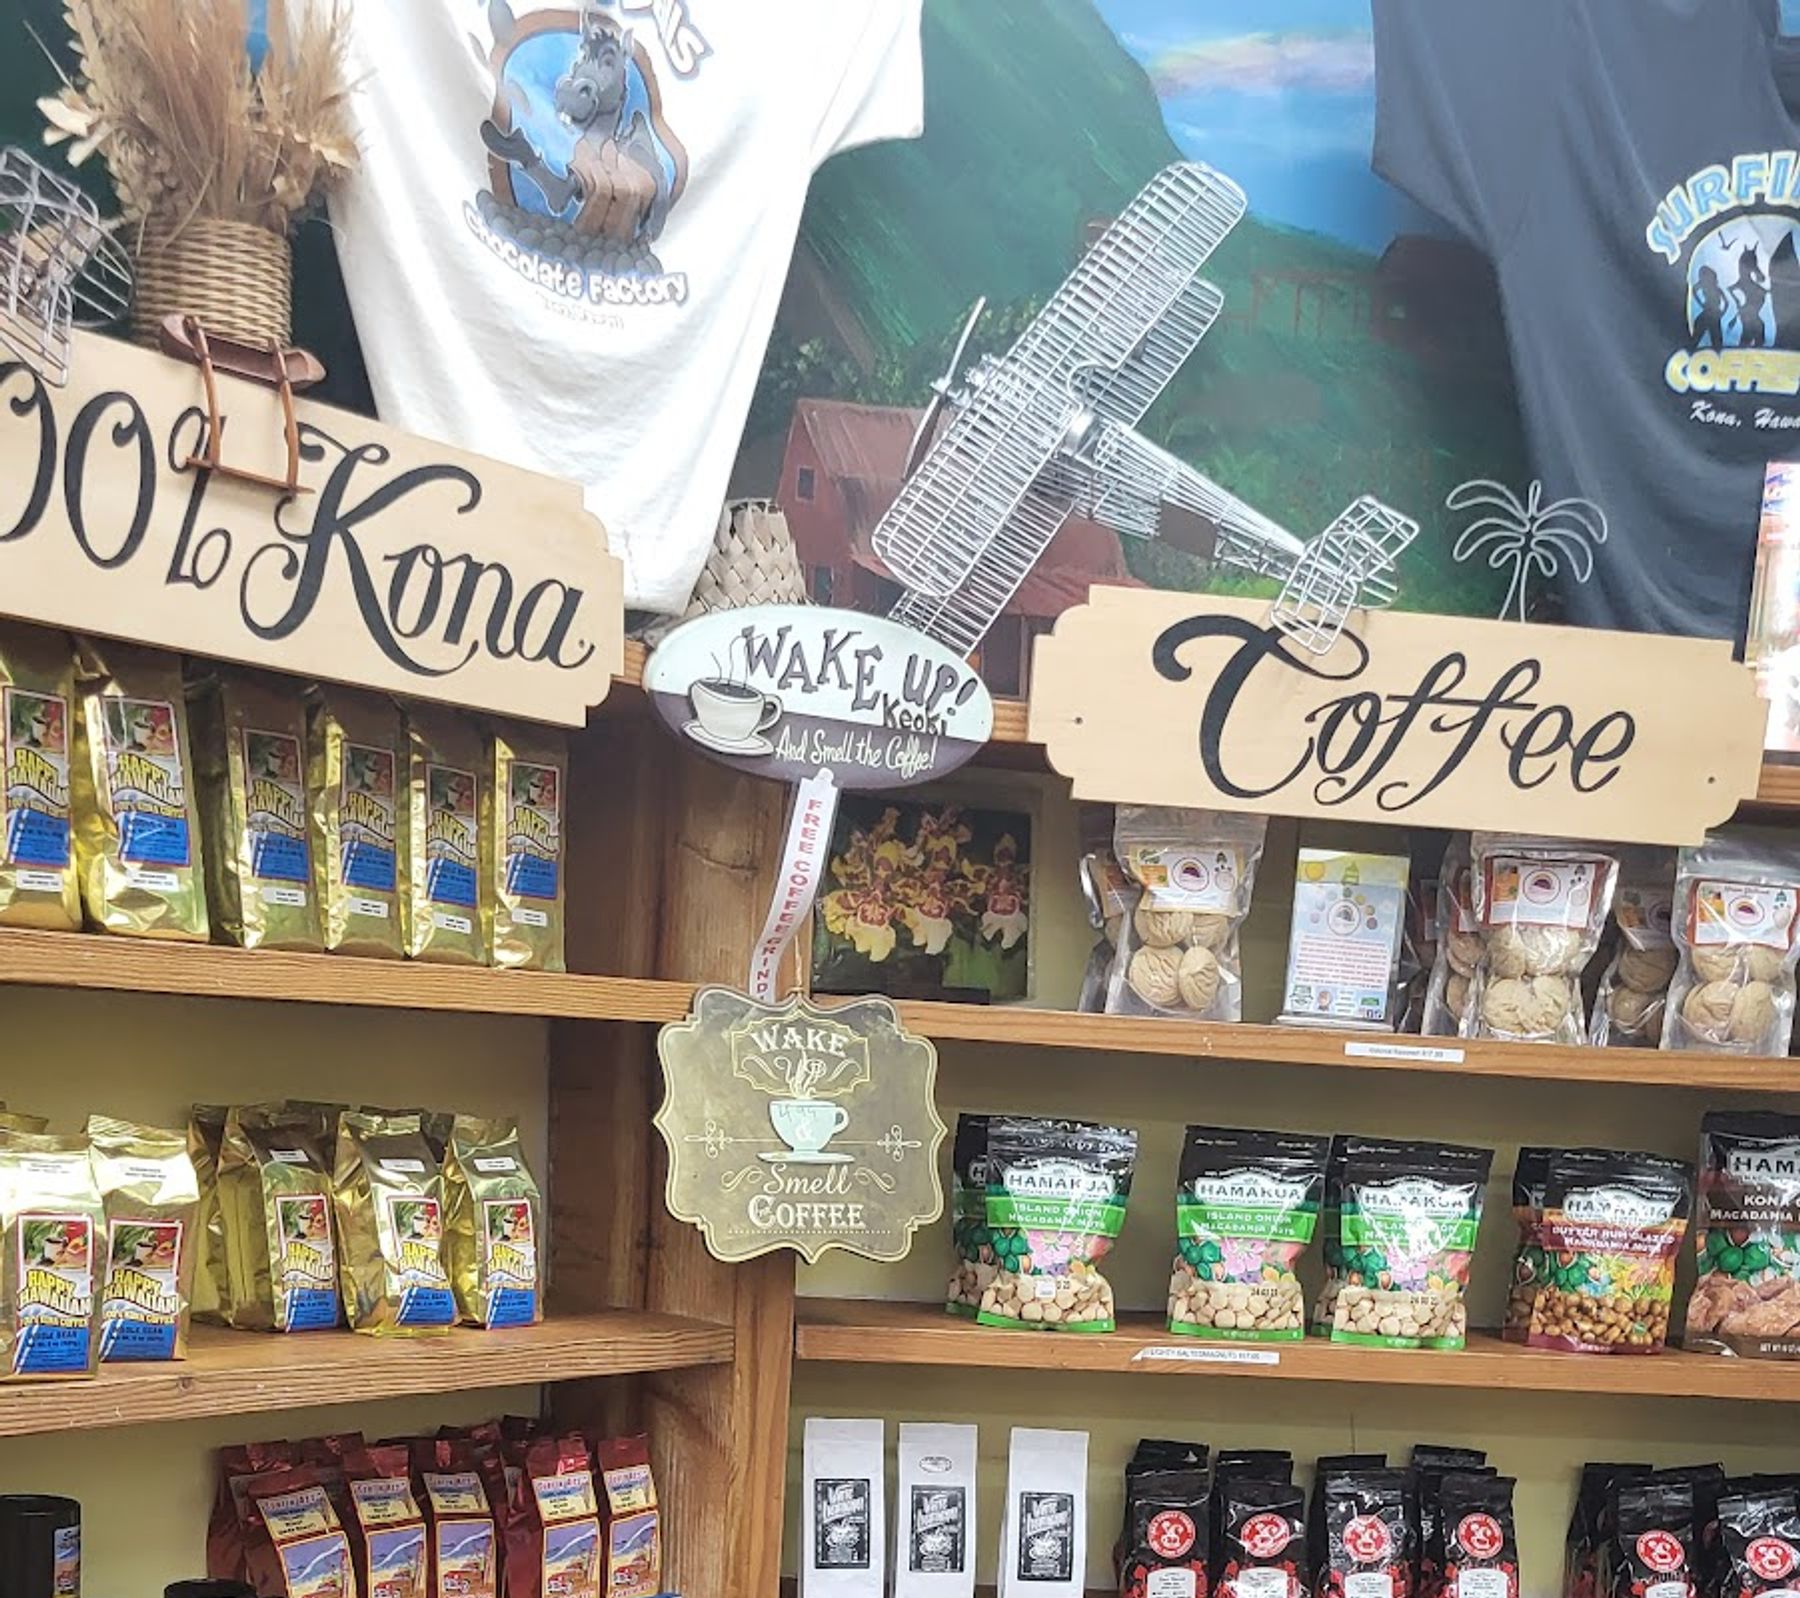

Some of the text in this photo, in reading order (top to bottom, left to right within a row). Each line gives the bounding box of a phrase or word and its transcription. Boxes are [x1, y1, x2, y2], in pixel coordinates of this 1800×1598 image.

[462, 200, 689, 306] Chocolate Factory
[240, 422, 596, 677] Kona
[741, 624, 978, 717] WAKE UP!
[1152, 613, 1637, 811] Coffee
[775, 725, 935, 779] And Smell the Coffee!
[756, 799, 823, 1000] FREE COFFEE GRIND
[751, 1024, 850, 1058] WAKE
[763, 1163, 852, 1195] Smell
[1734, 1155, 1800, 1174] HAM
[1014, 1202, 1061, 1214] ISLAND
[1200, 1184, 1301, 1200] HAMAKUA
[1743, 1195, 1790, 1208] KONA
[749, 1194, 866, 1230] COFFEE
[1206, 1211, 1252, 1222] ISLAND
[1710, 1208, 1793, 1222] MACADAMIA
